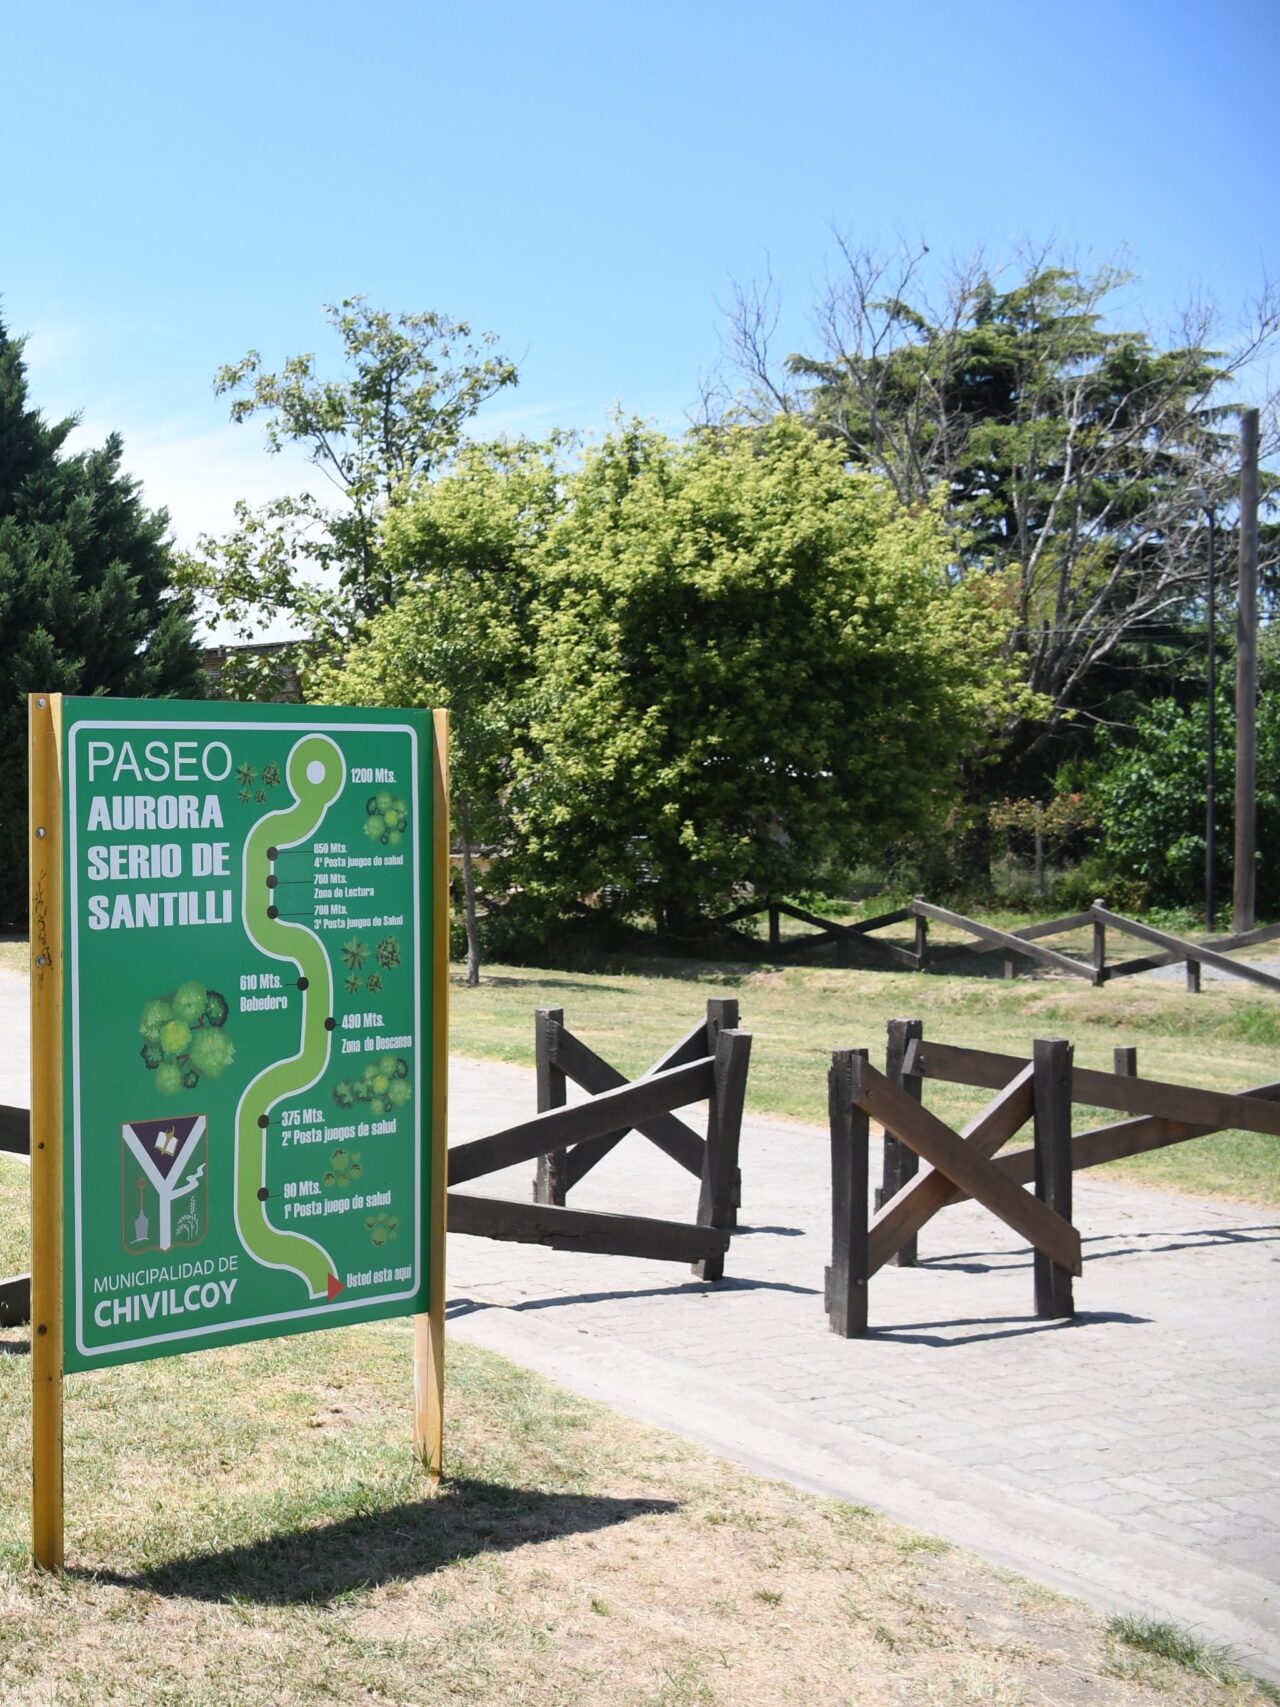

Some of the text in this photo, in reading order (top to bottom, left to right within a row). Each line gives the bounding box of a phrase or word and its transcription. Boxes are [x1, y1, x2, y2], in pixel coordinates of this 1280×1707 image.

[88, 741, 232, 782] PASEO
[351, 768, 396, 783] 1200 Mts.
[87, 795, 224, 831] AURORA
[88, 842, 230, 881] SERIO DE
[384, 855, 403, 865] salud
[314, 888, 332, 899] Zona
[345, 887, 374, 897] Lectura
[88, 890, 232, 930] SANTILLI
[323, 918, 346, 929] Posta
[240, 973, 282, 991] 610 Mts.
[240, 995, 288, 1012] Bebedero
[363, 1013, 385, 1028] Mts.
[342, 1035, 412, 1053] Zona de Descanso
[282, 1108, 325, 1127] 375 Mts.
[293, 1128, 322, 1145] Posta
[323, 1126, 356, 1143] juegos
[357, 1122, 369, 1137] de
[371, 1118, 396, 1135] salud
[284, 1181, 322, 1199] 90 Mts.
[294, 1201, 322, 1218] Posta
[323, 1198, 350, 1216] juego
[352, 1194, 364, 1209] de
[366, 1190, 391, 1207] salud
[94, 1255, 238, 1293] MUNICIPALIDAD DE
[347, 1270, 372, 1288] Usted
[373, 1268, 393, 1284] esta
[94, 1278, 238, 1328] CHIVILCOY
